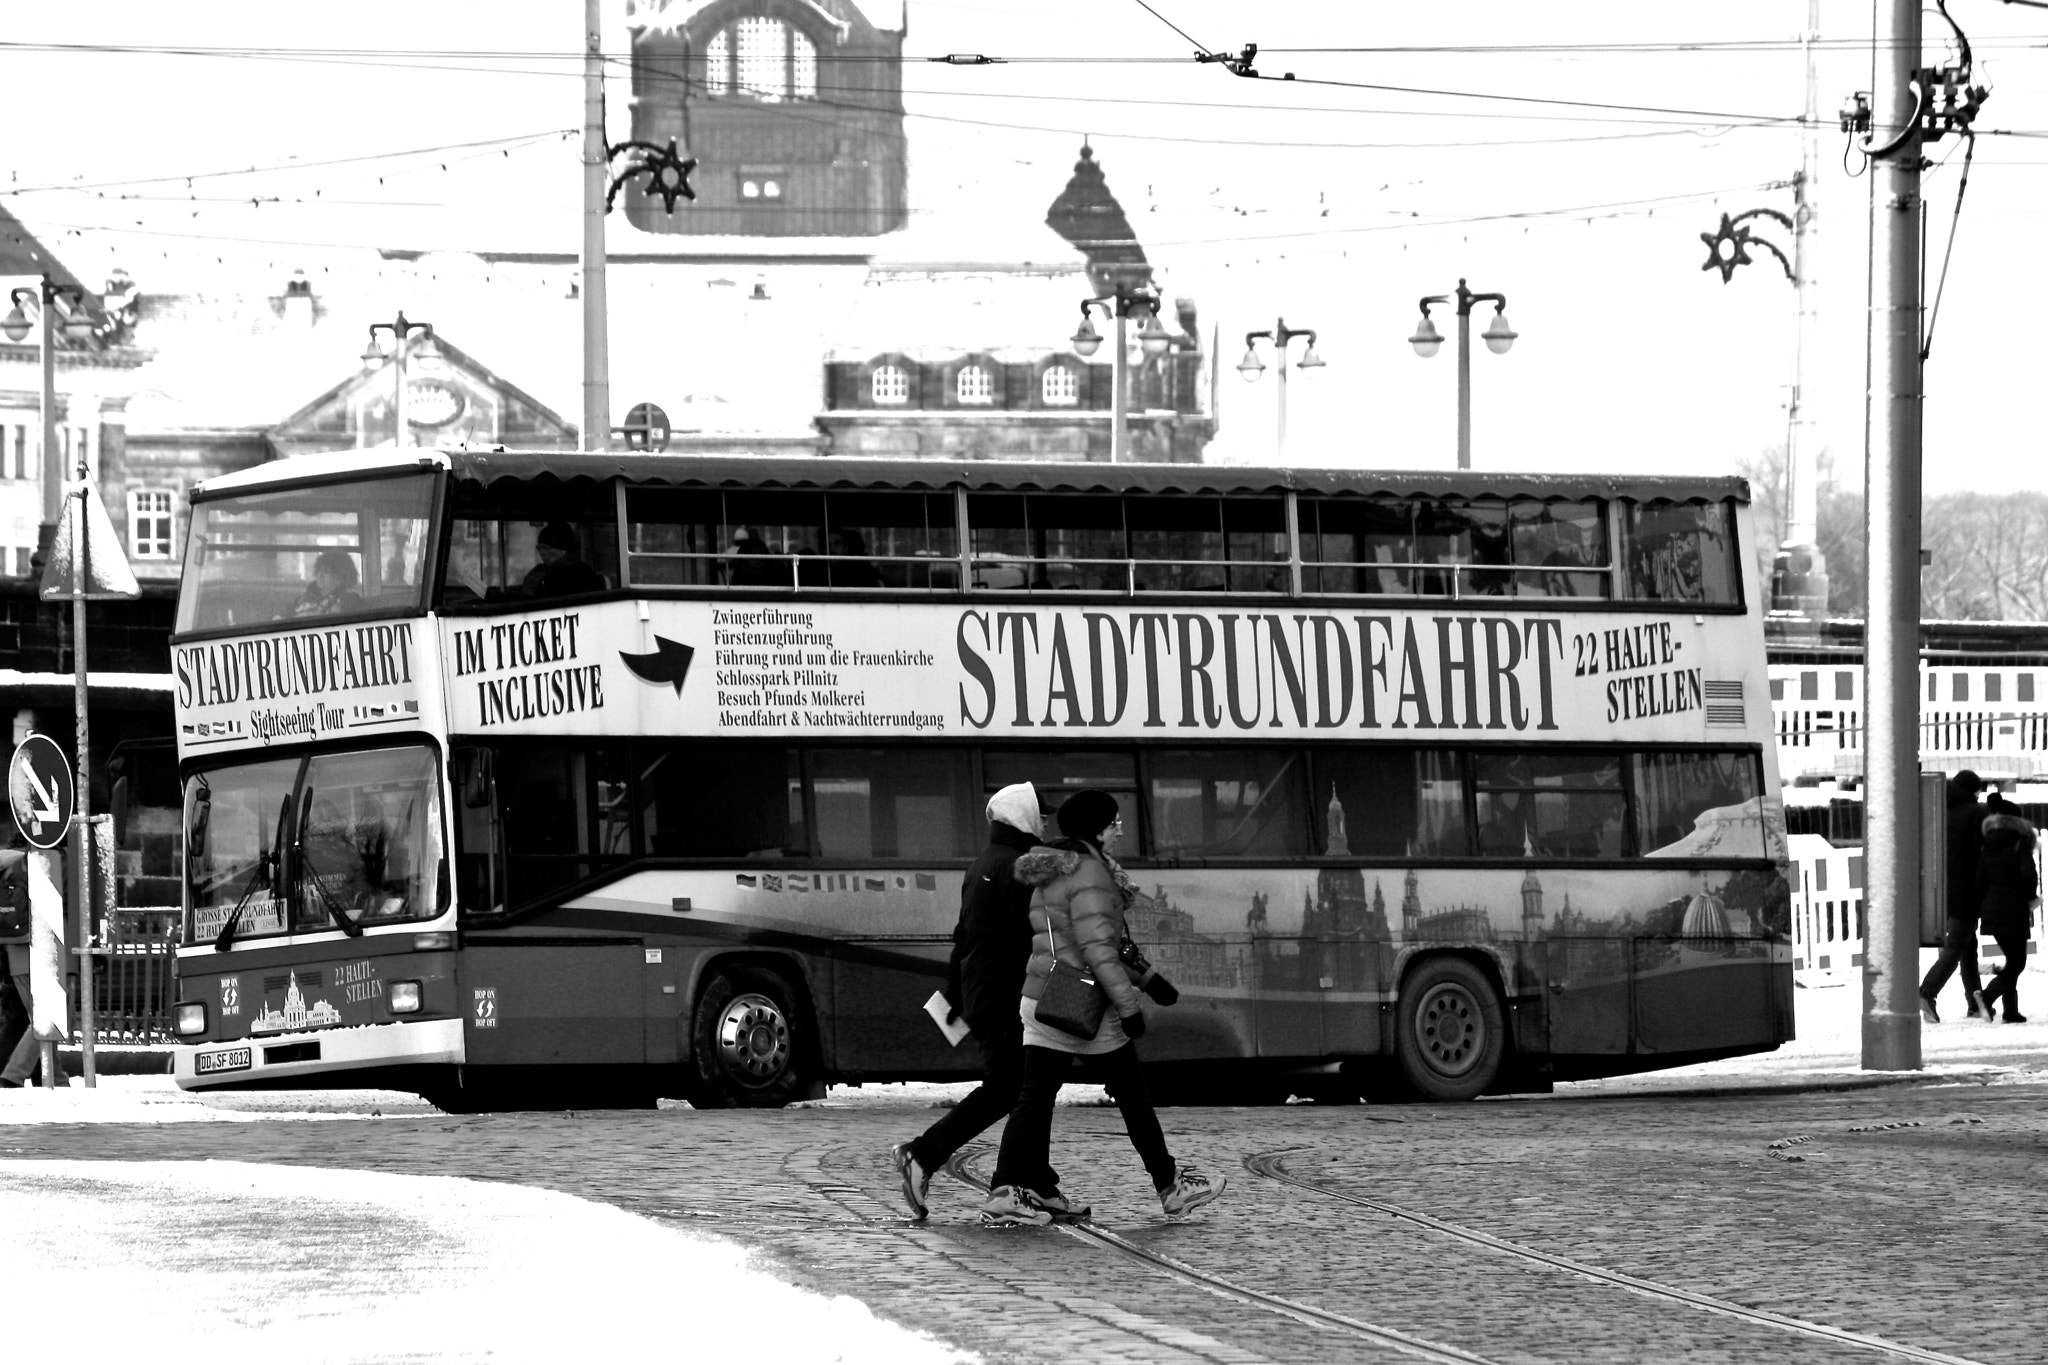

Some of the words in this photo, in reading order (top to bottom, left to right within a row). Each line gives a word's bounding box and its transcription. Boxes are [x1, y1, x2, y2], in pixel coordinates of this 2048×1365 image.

[712, 608, 813, 628] Zwingerführung
[454, 628, 486, 677] IM
[490, 613, 579, 672] TICKET
[713, 629, 833, 649] Fürstenzugführung
[1573, 632, 1599, 677] 22
[1603, 621, 1682, 673] HALTE-
[176, 622, 413, 710] STADTRUNDFAHRT
[715, 649, 769, 669] Führung
[771, 649, 802, 666] rund
[806, 653, 826, 666] um
[830, 649, 849, 666] die
[853, 650, 934, 666] Frauenkirche
[716, 670, 790, 690] Schlosspark
[793, 670, 839, 686] Pillnitz
[956, 609, 1563, 731] STADTRUNDFAHRT
[477, 664, 604, 727] INCLUSIVE
[717, 690, 761, 706] Besuch
[764, 690, 808, 706] Pfunds
[811, 690, 865, 706] Molkerei
[1606, 667, 1703, 723] STELLEN
[250, 705, 317, 746] Sightseeing
[316, 702, 345, 731] Tour
[718, 710, 787, 727] Abendfahrt
[790, 711, 801, 727] &
[804, 710, 945, 731] Nachtwächterrundgang
[196, 907, 221, 924] GROSSE
[334, 966, 344, 986] 22
[345, 978, 383, 1004] STELLEN
[201, 1055, 212, 1070] DD
[216, 1053, 227, 1068] SF
[228, 1050, 249, 1066] 8012
